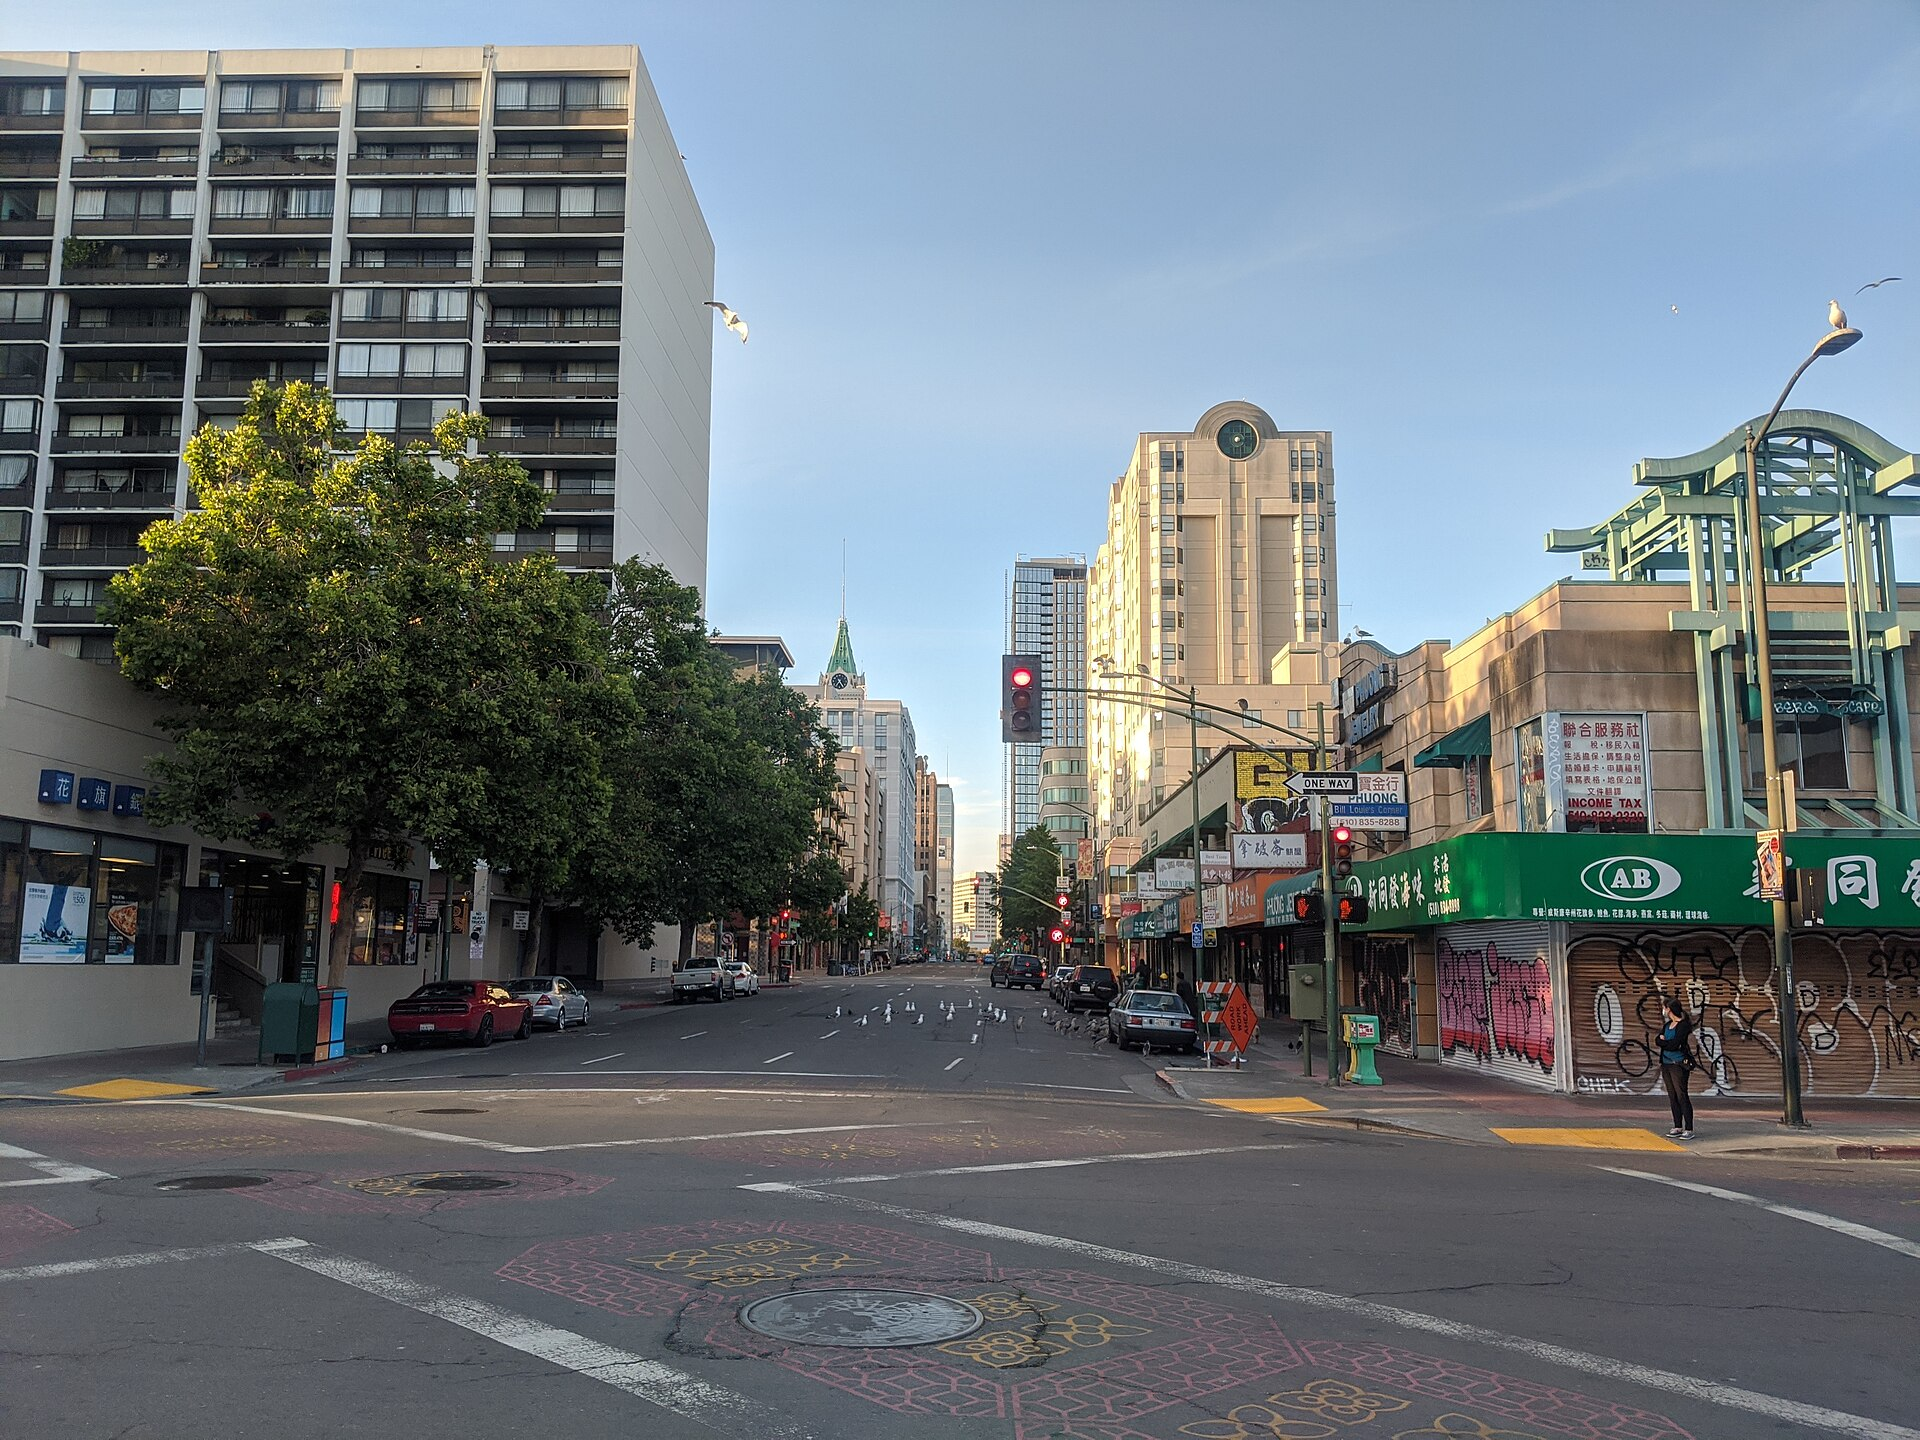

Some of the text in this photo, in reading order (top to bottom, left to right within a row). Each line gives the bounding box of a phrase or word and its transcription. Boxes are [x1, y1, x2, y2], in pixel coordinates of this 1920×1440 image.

[1562, 722, 1639, 738] 聯合服務社
[1304, 779, 1350, 788] ONE WAY
[1348, 793, 1398, 803] PHUONG
[1568, 798, 1642, 808] INCOME TAX
[1334, 804, 1403, 813] Bill Louie's Corner
[1359, 818, 1400, 826] 835-8288
[1610, 868, 1652, 889] AB
